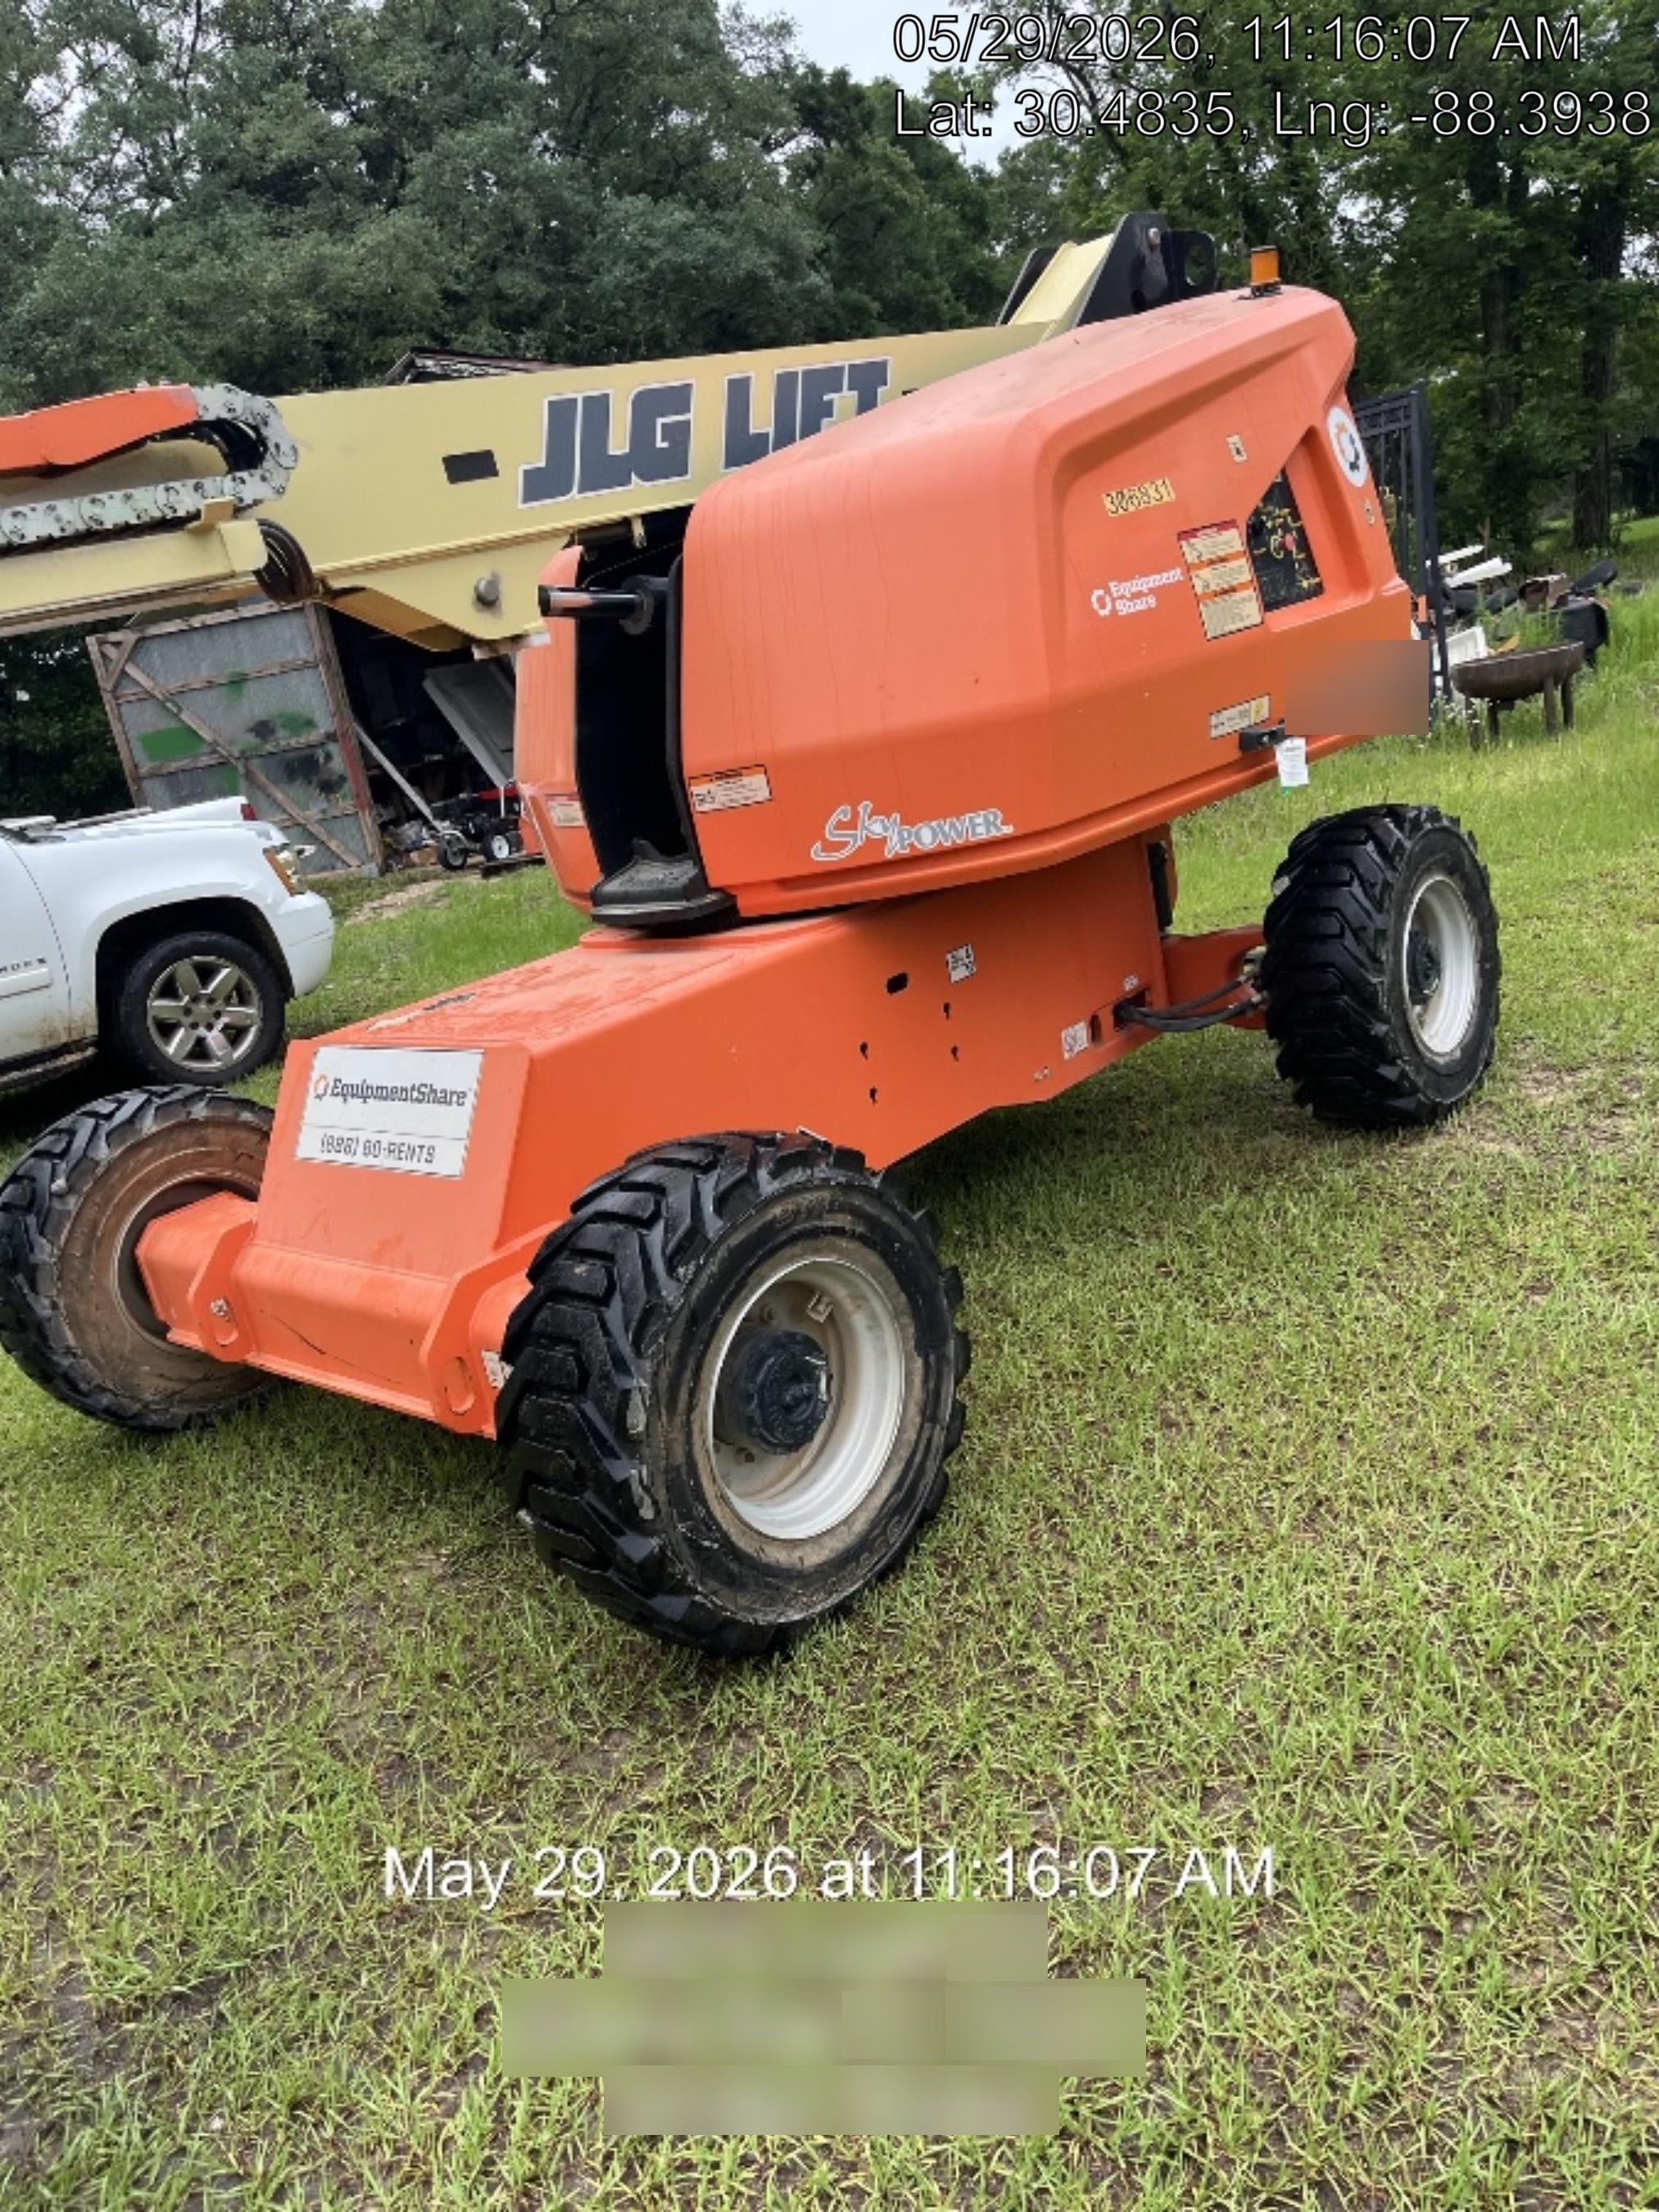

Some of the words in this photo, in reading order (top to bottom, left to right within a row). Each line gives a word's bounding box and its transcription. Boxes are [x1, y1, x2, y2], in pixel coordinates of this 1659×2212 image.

[519, 380, 695, 510] JLG
[722, 356, 891, 473] LIFT
[329, 1078, 469, 1107] EquipmentShare
